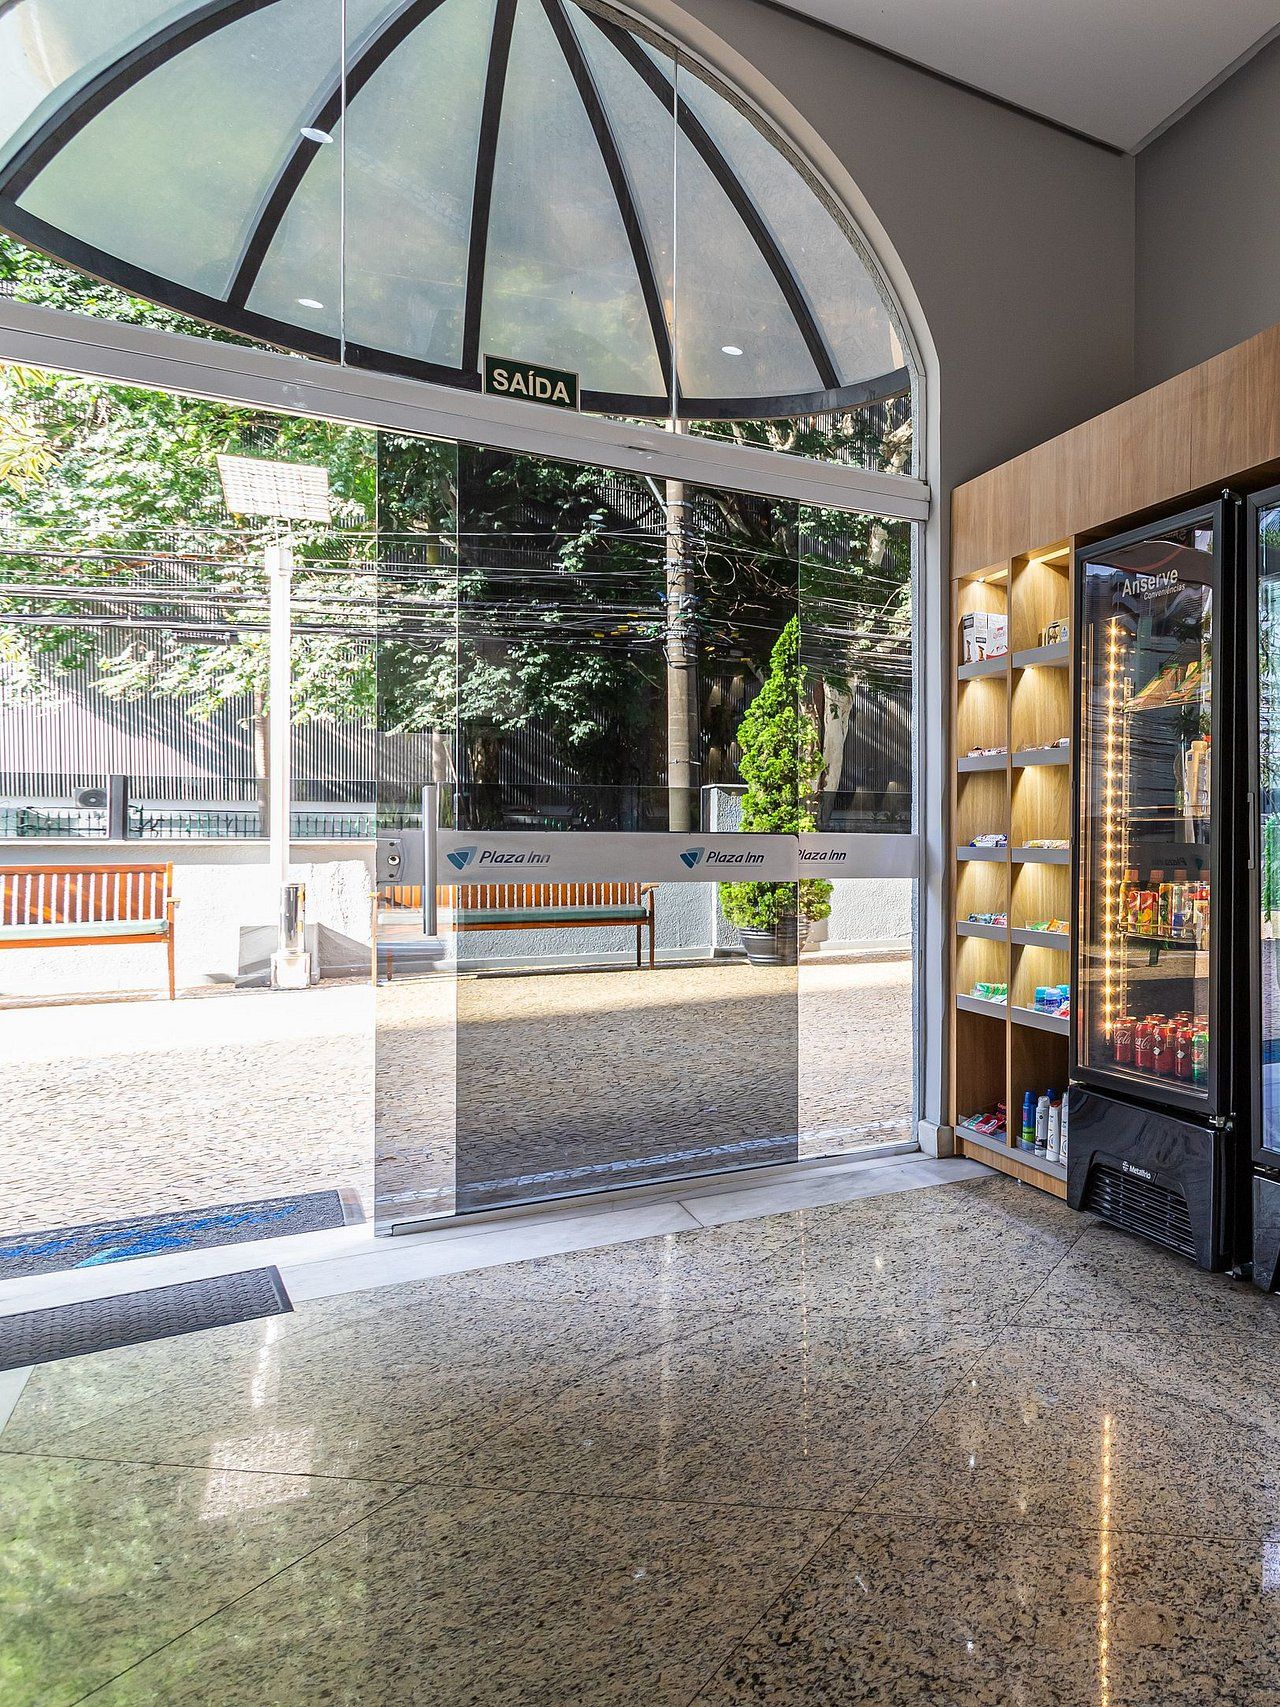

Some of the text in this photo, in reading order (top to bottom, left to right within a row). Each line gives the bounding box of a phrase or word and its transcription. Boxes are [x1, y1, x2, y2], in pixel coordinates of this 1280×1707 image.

[492, 367, 571, 404] SAÍDA
[1121, 569, 1179, 598] Anserve
[478, 850, 551, 863] Plaza Inn
[705, 850, 765, 864] Plaza Inn
[828, 849, 847, 861] Inn
